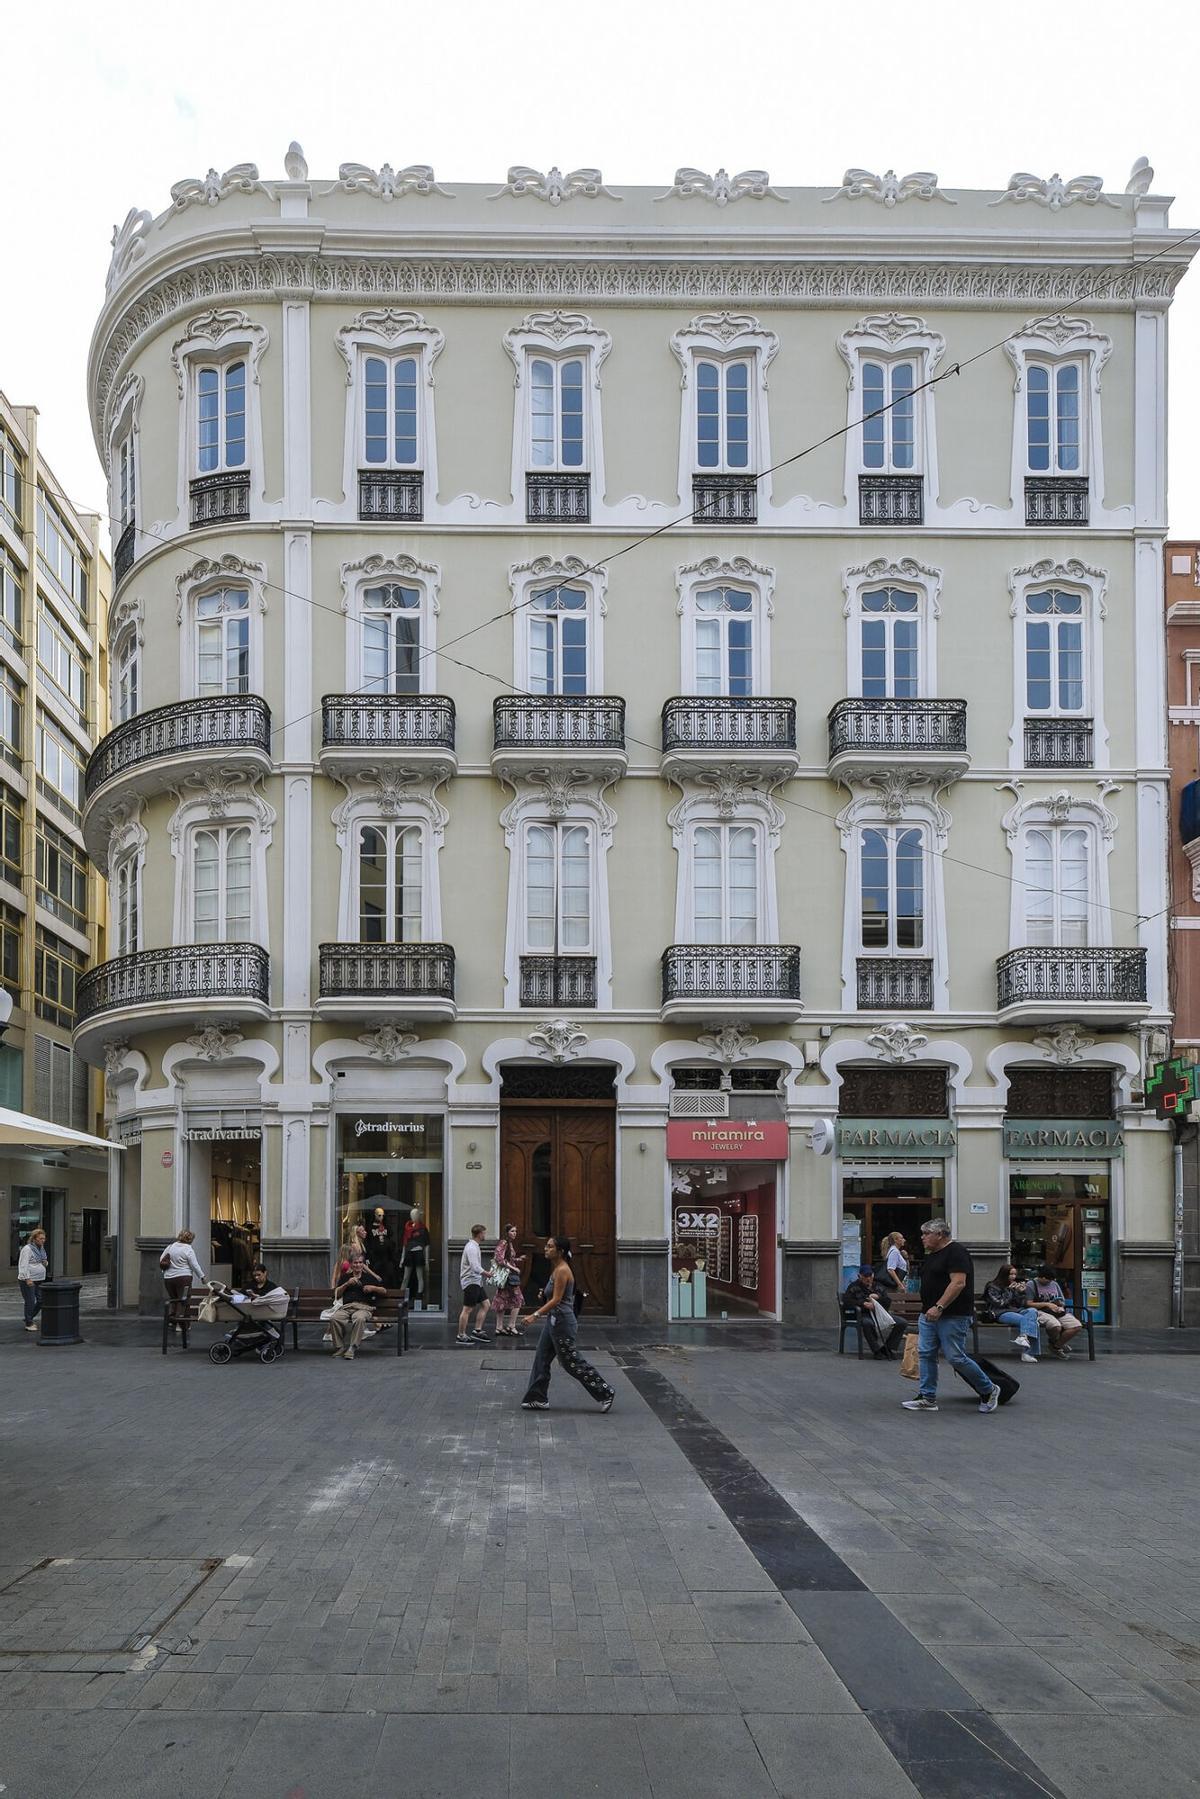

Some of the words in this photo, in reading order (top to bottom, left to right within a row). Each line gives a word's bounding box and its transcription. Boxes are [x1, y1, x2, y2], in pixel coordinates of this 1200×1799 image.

[182, 1126, 262, 1140] stradivarius
[361, 1121, 425, 1133] stradivarius
[692, 1131, 764, 1140] miramira
[840, 1128, 959, 1146] FARMACIA
[1007, 1128, 1124, 1147] FARMACIA
[465, 1161, 482, 1170] 65
[678, 1212, 719, 1229] 3X2
